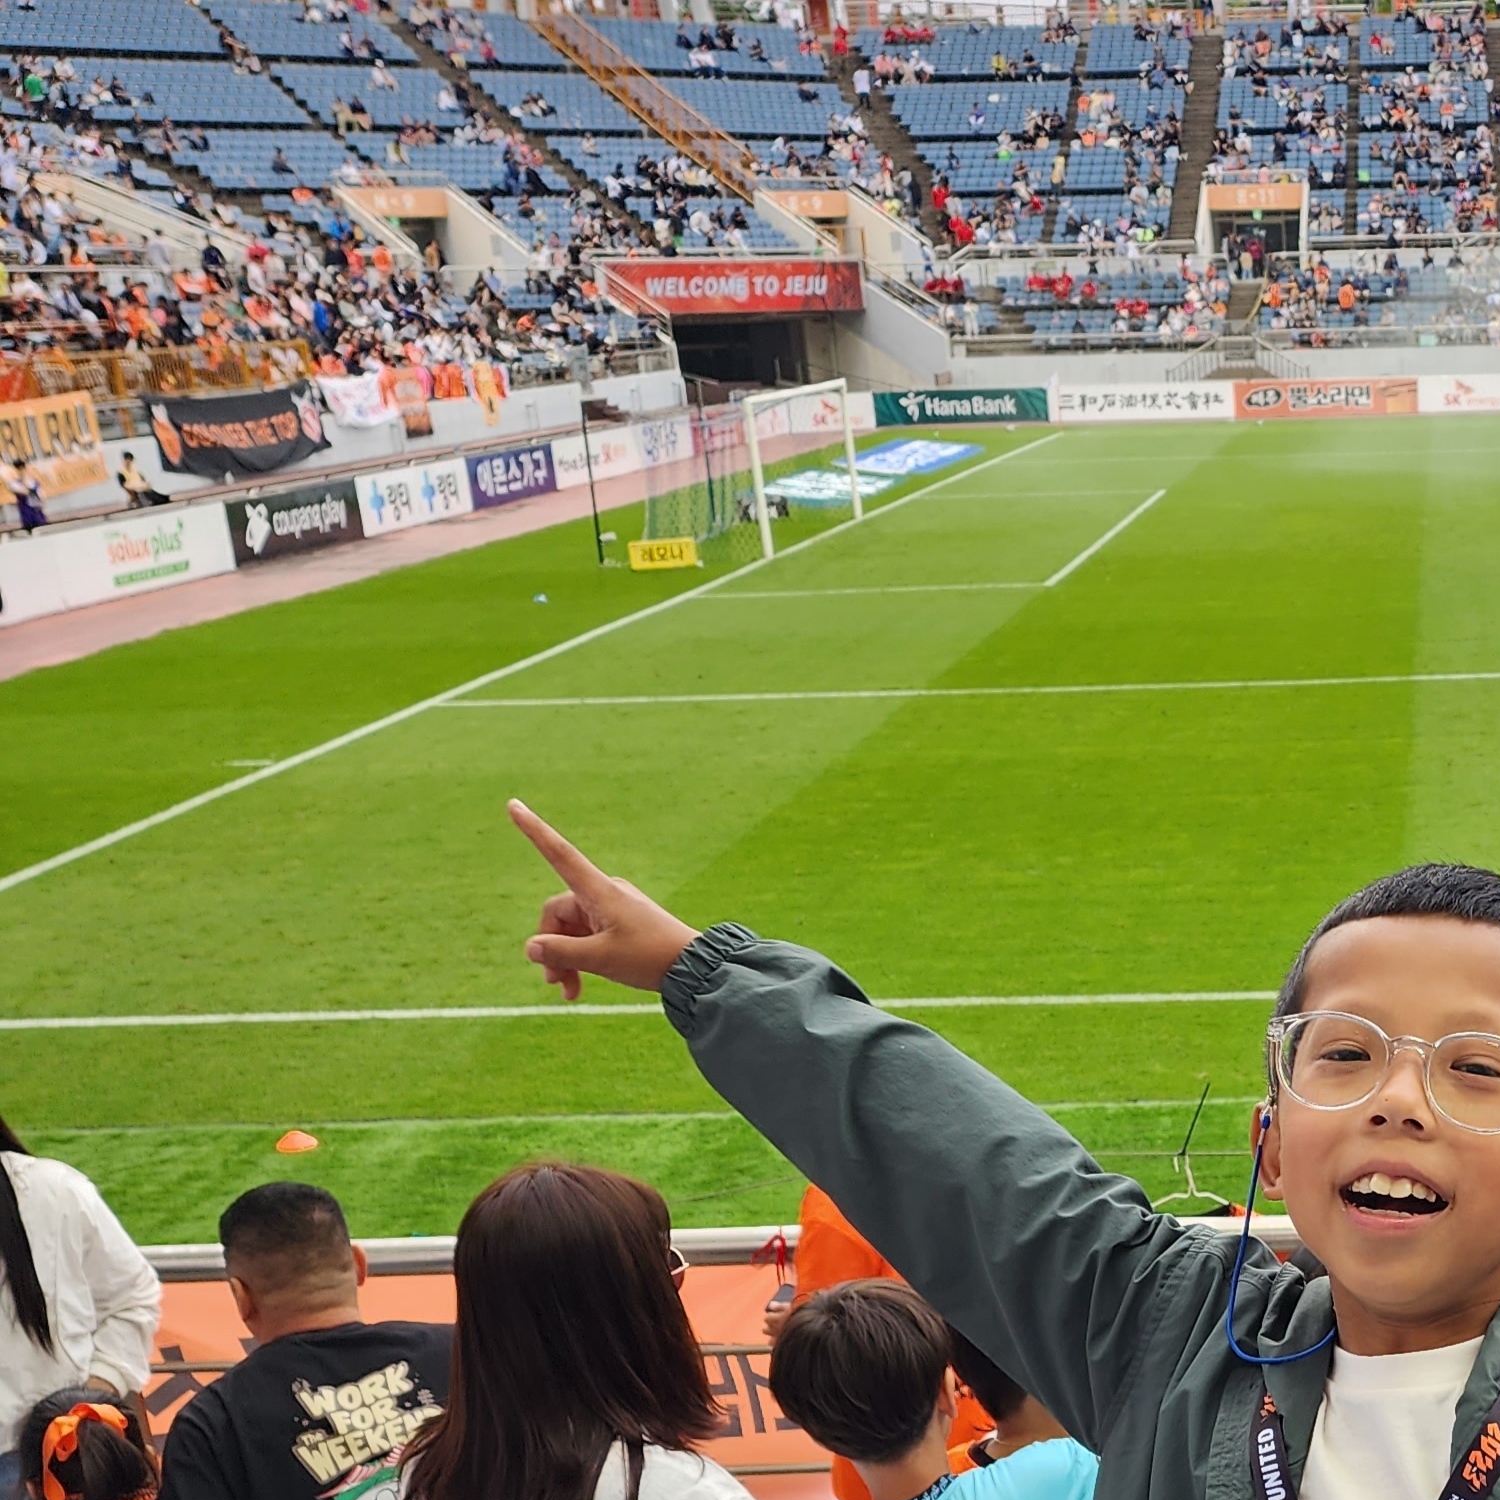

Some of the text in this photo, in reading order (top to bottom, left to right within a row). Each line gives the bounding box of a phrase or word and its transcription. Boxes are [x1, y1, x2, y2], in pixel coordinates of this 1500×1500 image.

[645, 275, 828, 301] WELCOME TO JEJU
[319, 494, 347, 533] play
[151, 526, 182, 562] plus
[296, 1361, 414, 1420] WORK
[329, 1397, 400, 1435] FOR
